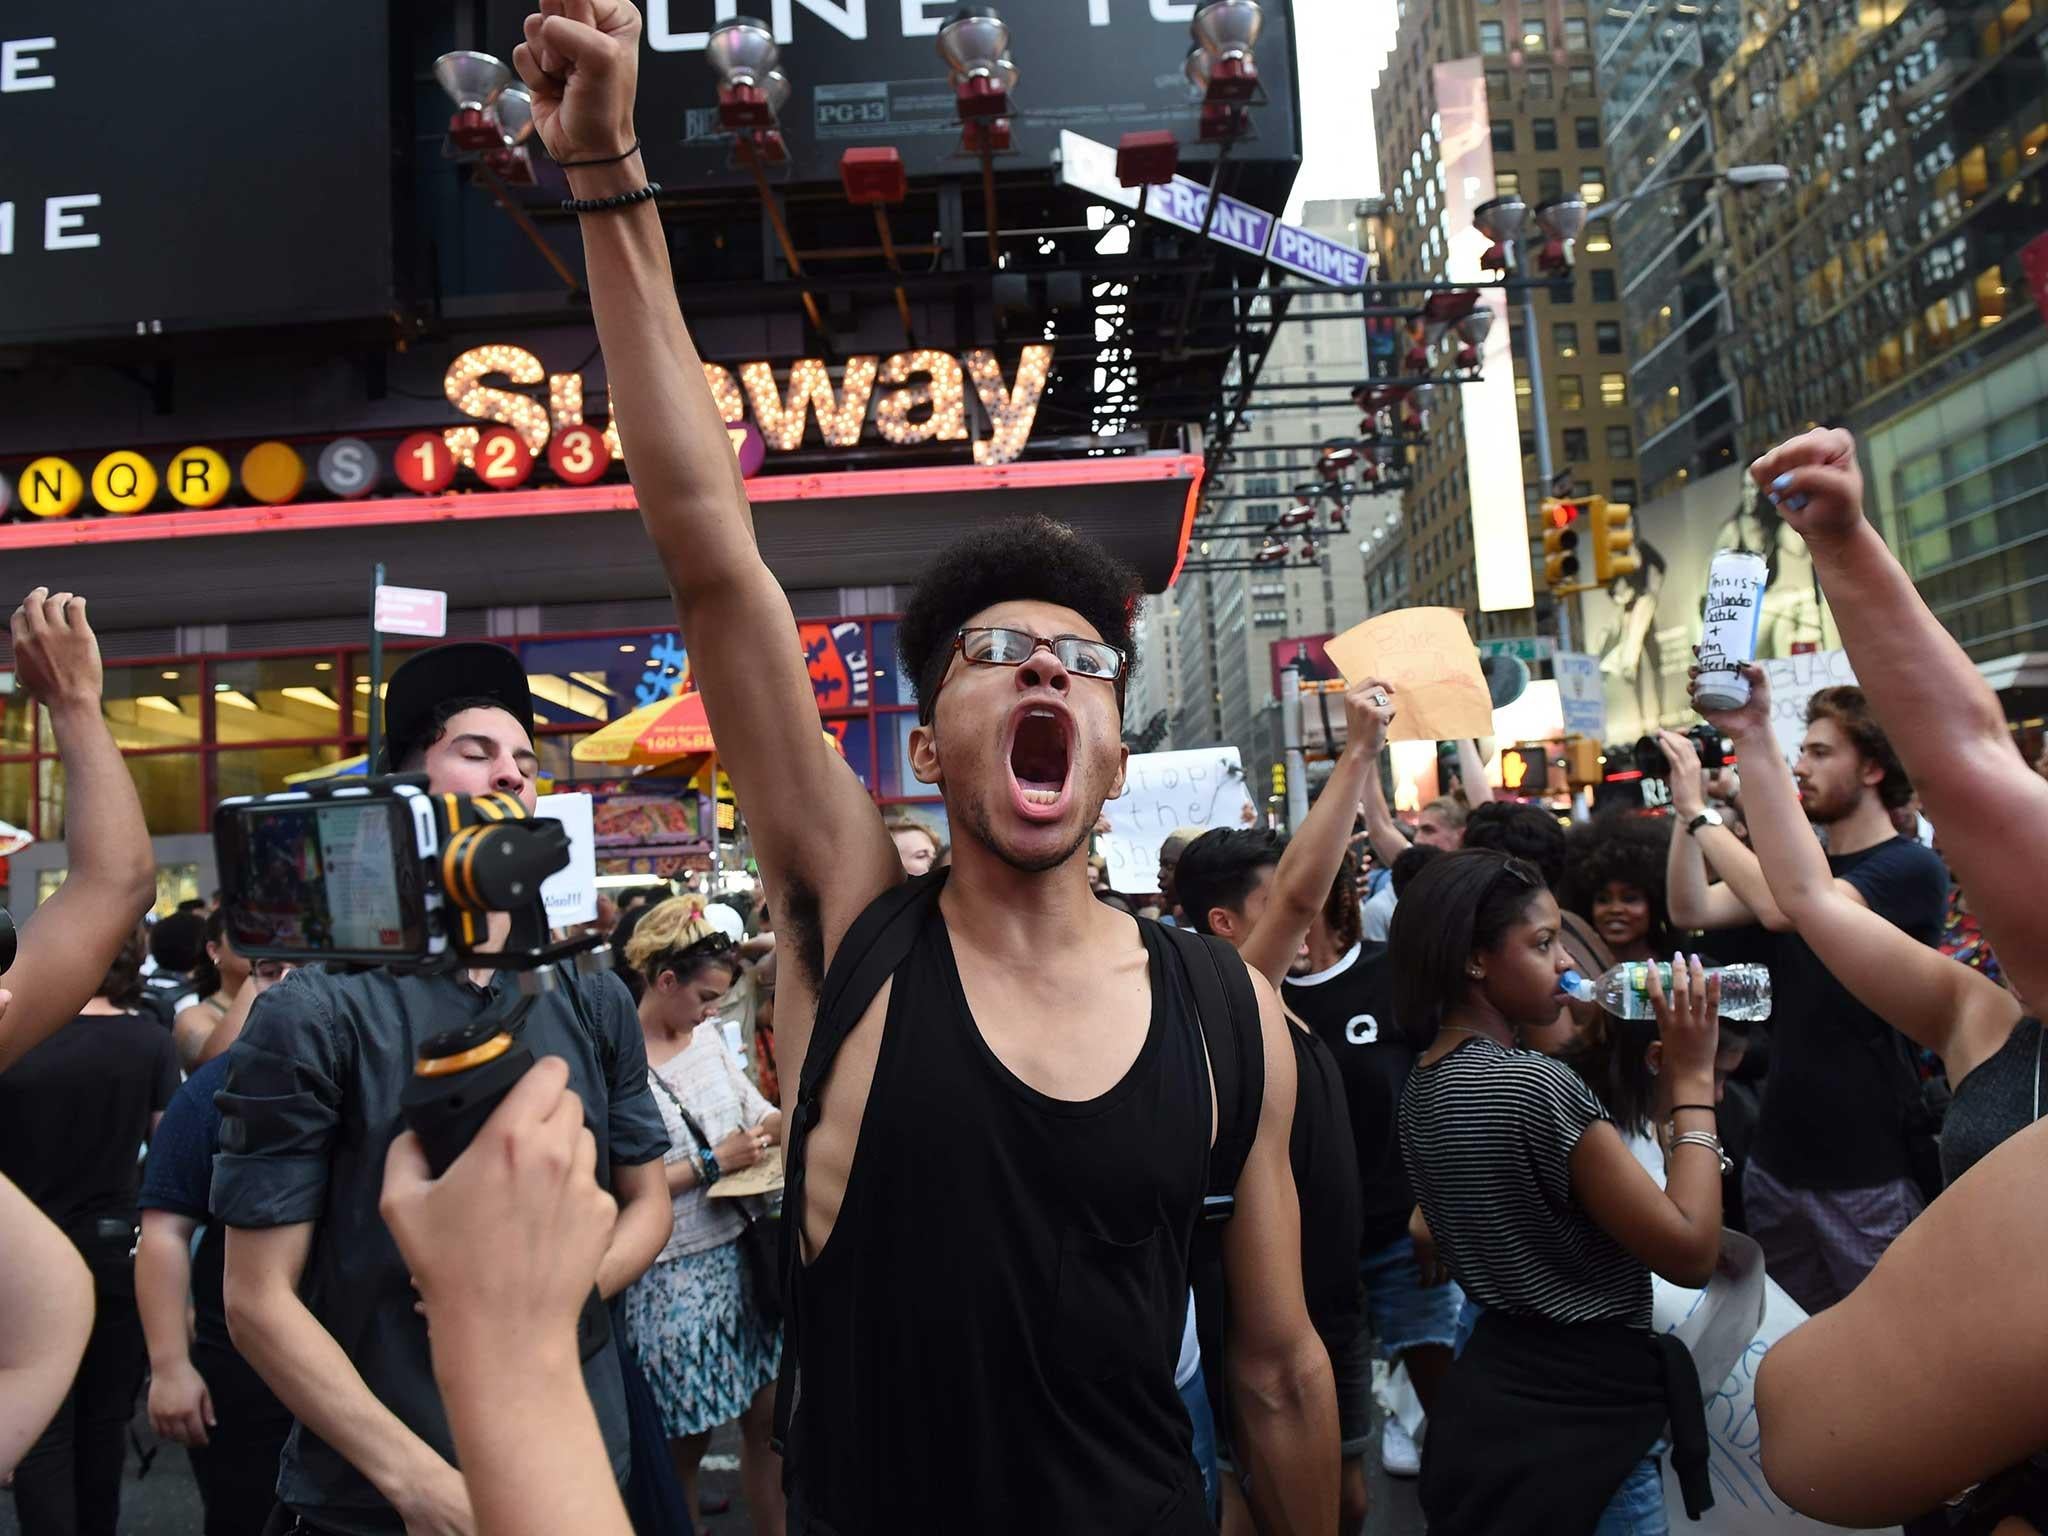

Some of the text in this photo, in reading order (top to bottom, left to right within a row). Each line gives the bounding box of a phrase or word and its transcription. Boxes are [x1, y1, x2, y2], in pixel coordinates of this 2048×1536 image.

[819, 102, 885, 122] PG-13
[0, 193, 101, 255] E
[1280, 226, 1358, 283] PRIME
[34, 469, 62, 504] N
[107, 463, 137, 498] Q
[181, 459, 210, 493] R
[331, 447, 364, 486] S
[414, 442, 435, 481] 1
[486, 437, 517, 476] 2
[562, 432, 593, 472] 3
[1130, 799, 1208, 831] the
[1345, 1013, 1379, 1045] Q
